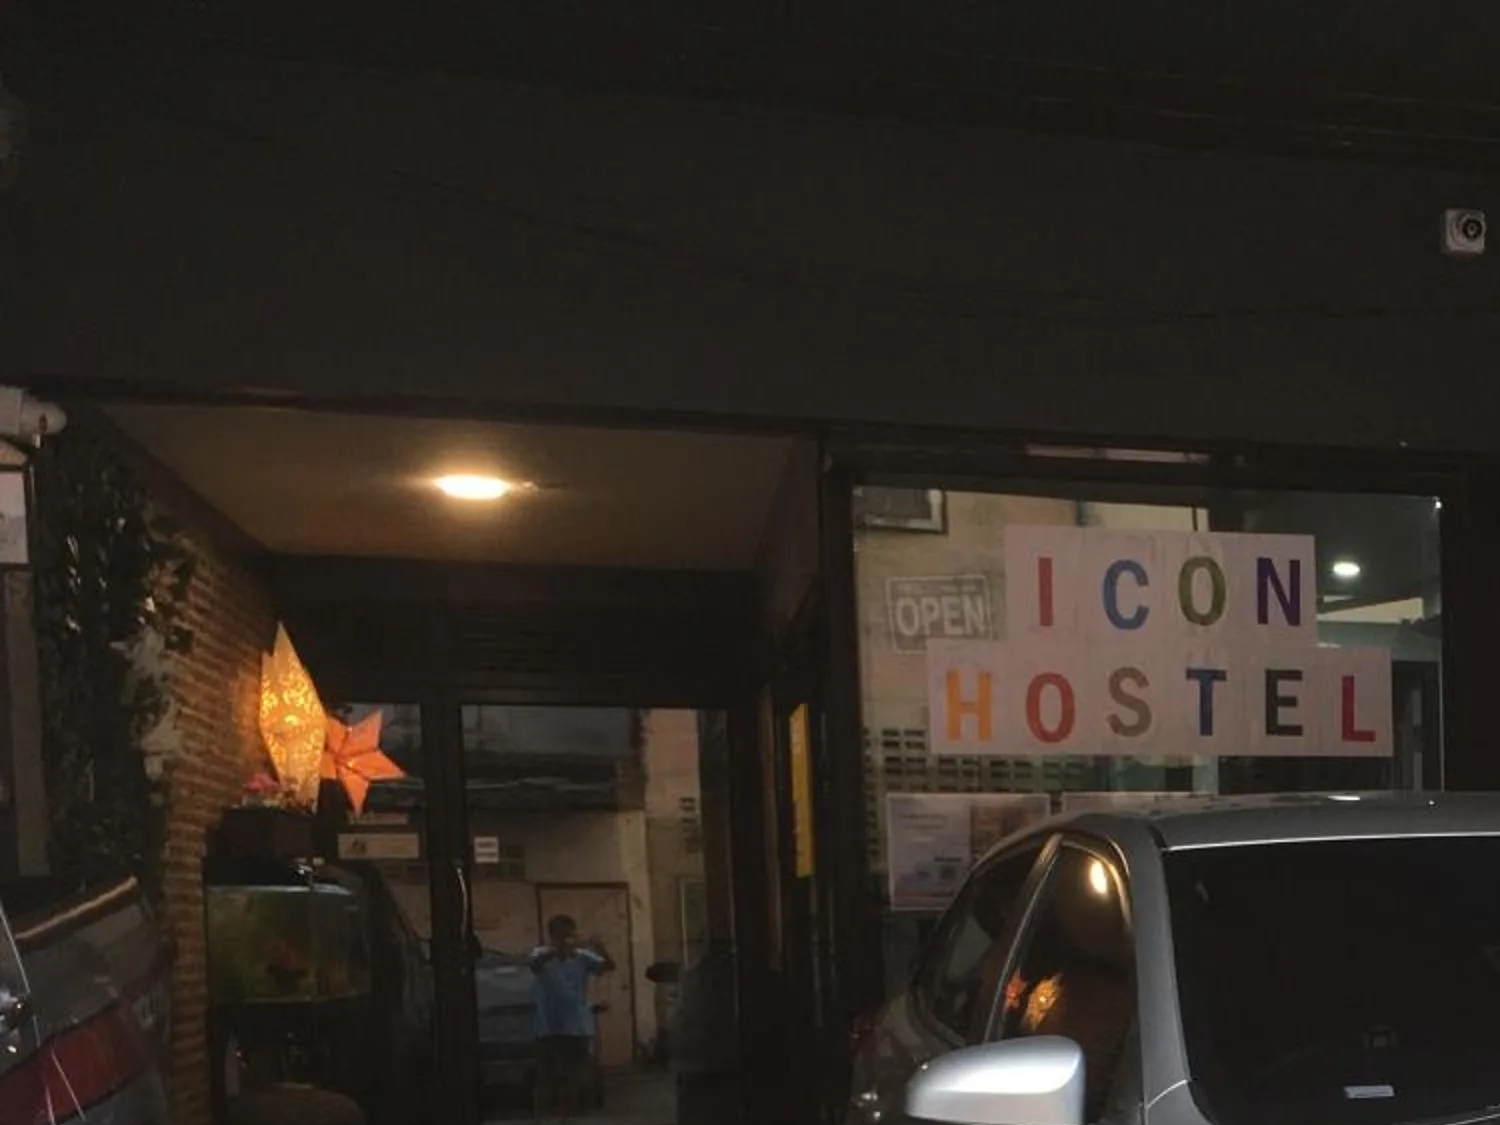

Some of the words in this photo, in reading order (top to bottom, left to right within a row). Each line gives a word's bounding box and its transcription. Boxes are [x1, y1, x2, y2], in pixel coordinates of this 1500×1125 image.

[896, 594, 985, 637] OPEN
[1038, 556, 1301, 630] ICON
[943, 666, 1377, 744] HOSTEL
